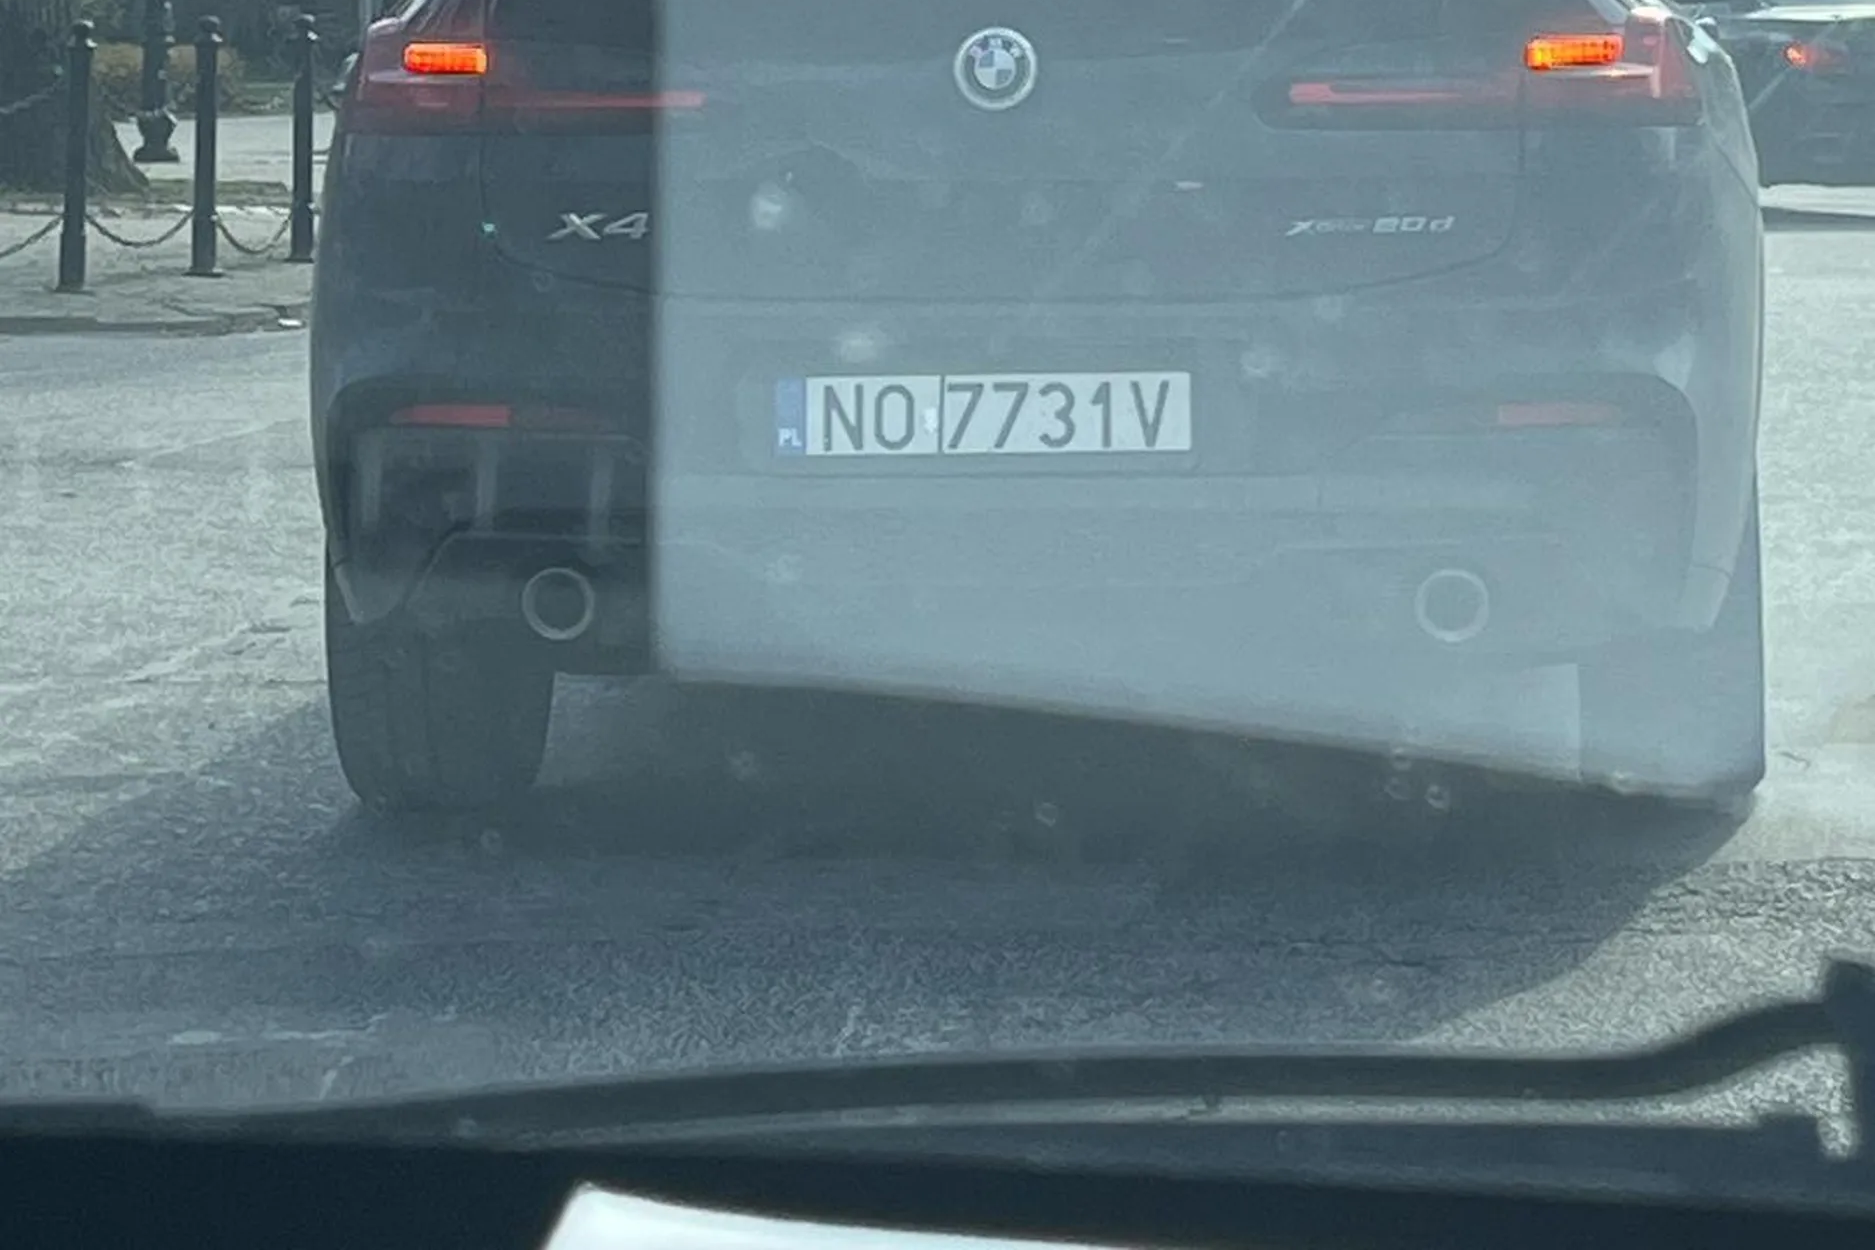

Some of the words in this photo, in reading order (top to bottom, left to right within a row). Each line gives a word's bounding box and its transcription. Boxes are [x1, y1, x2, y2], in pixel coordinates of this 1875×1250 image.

[547, 213, 649, 240] X4
[823, 384, 915, 452] NO
[946, 380, 1170, 450] 7731V
[779, 428, 802, 447] PL
